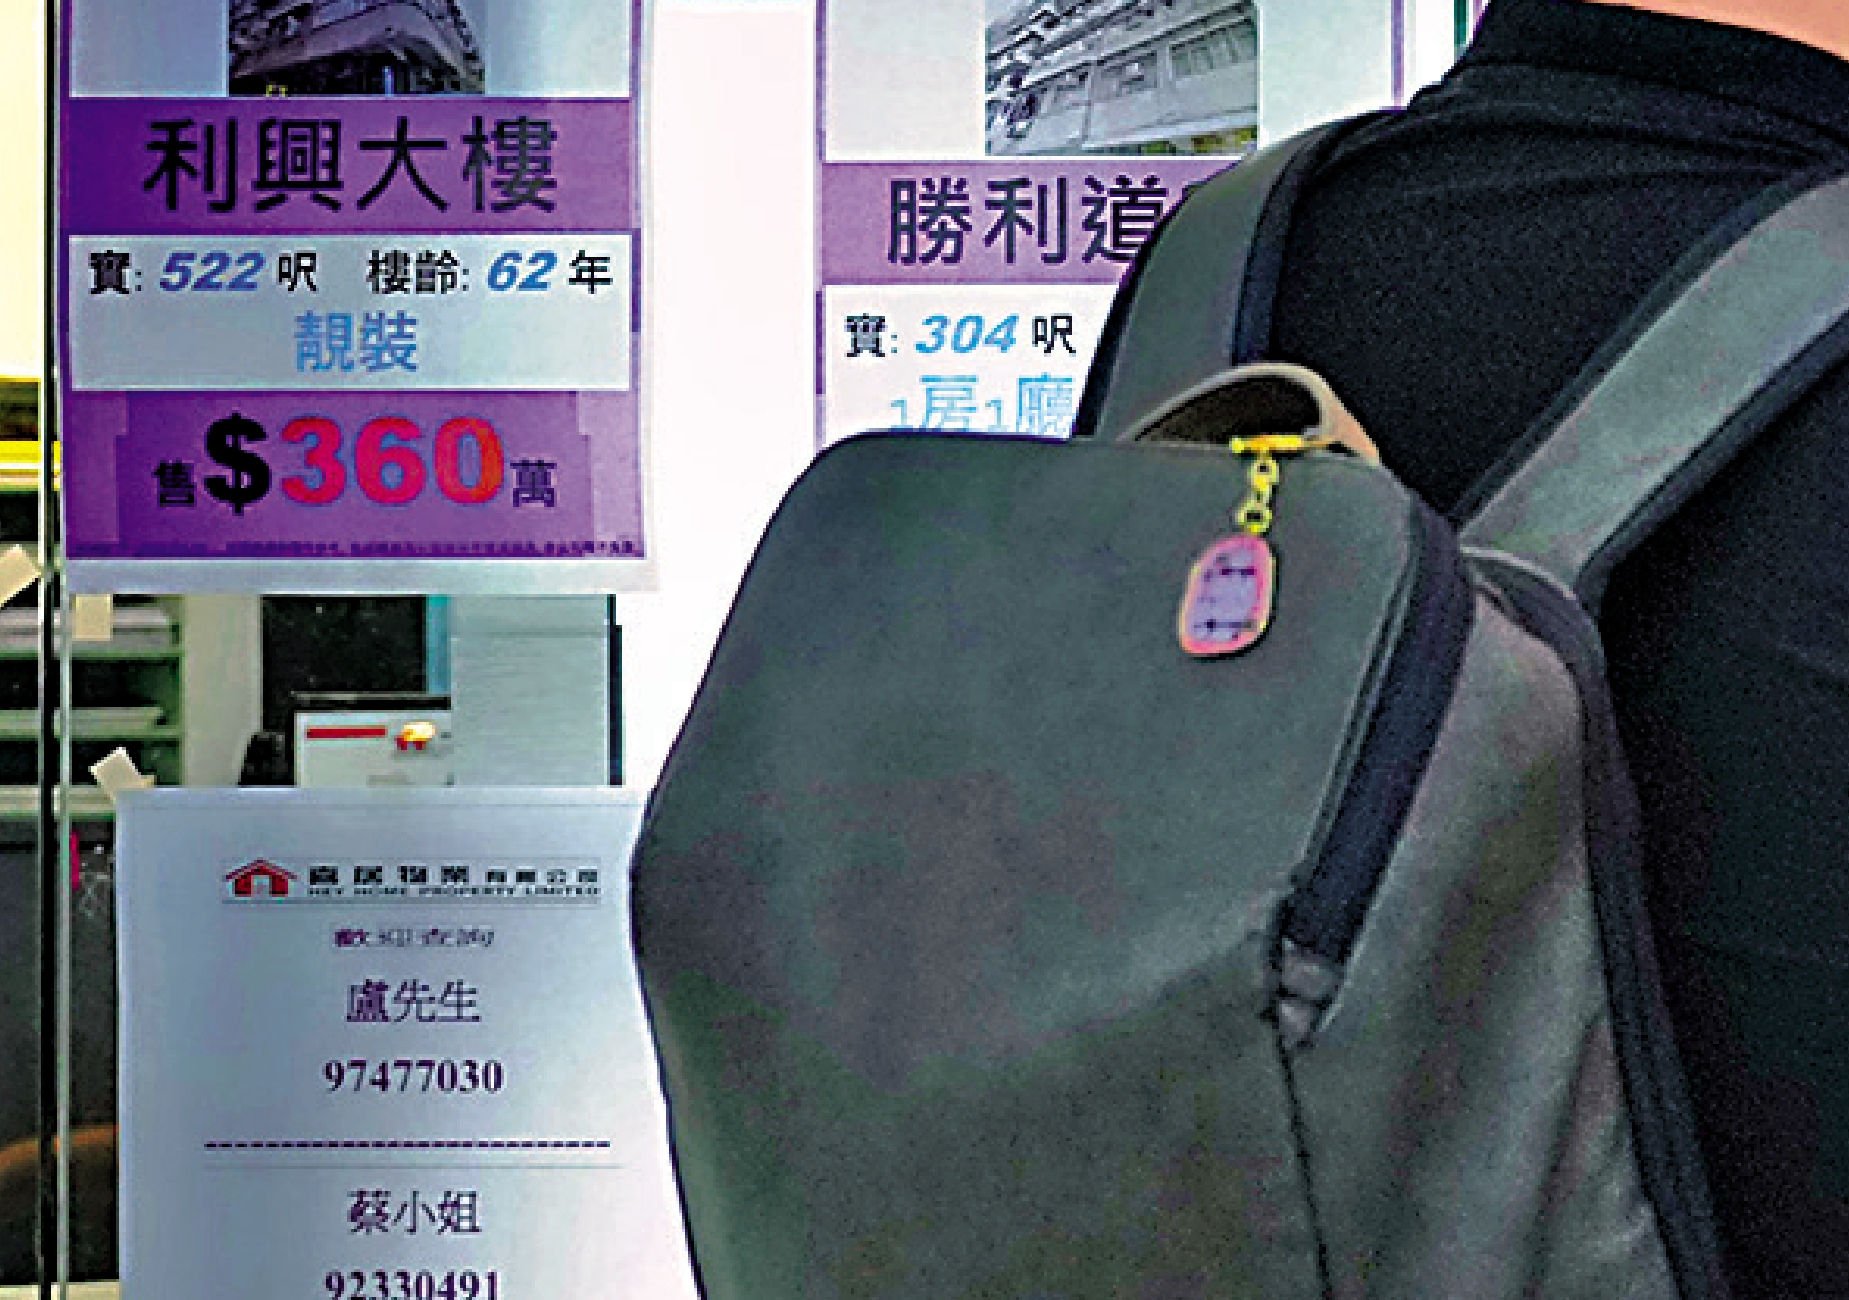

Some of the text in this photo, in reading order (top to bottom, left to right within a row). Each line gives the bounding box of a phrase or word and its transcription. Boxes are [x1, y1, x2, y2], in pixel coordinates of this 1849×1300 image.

[143, 116, 558, 214] 利興大樓
[159, 252, 264, 291] 522
[487, 252, 558, 291] 62
[568, 251, 612, 293] 年
[914, 315, 1016, 354] 304
[324, 1060, 504, 1092] 97477030
[347, 1191, 482, 1234] 蔡小姐
